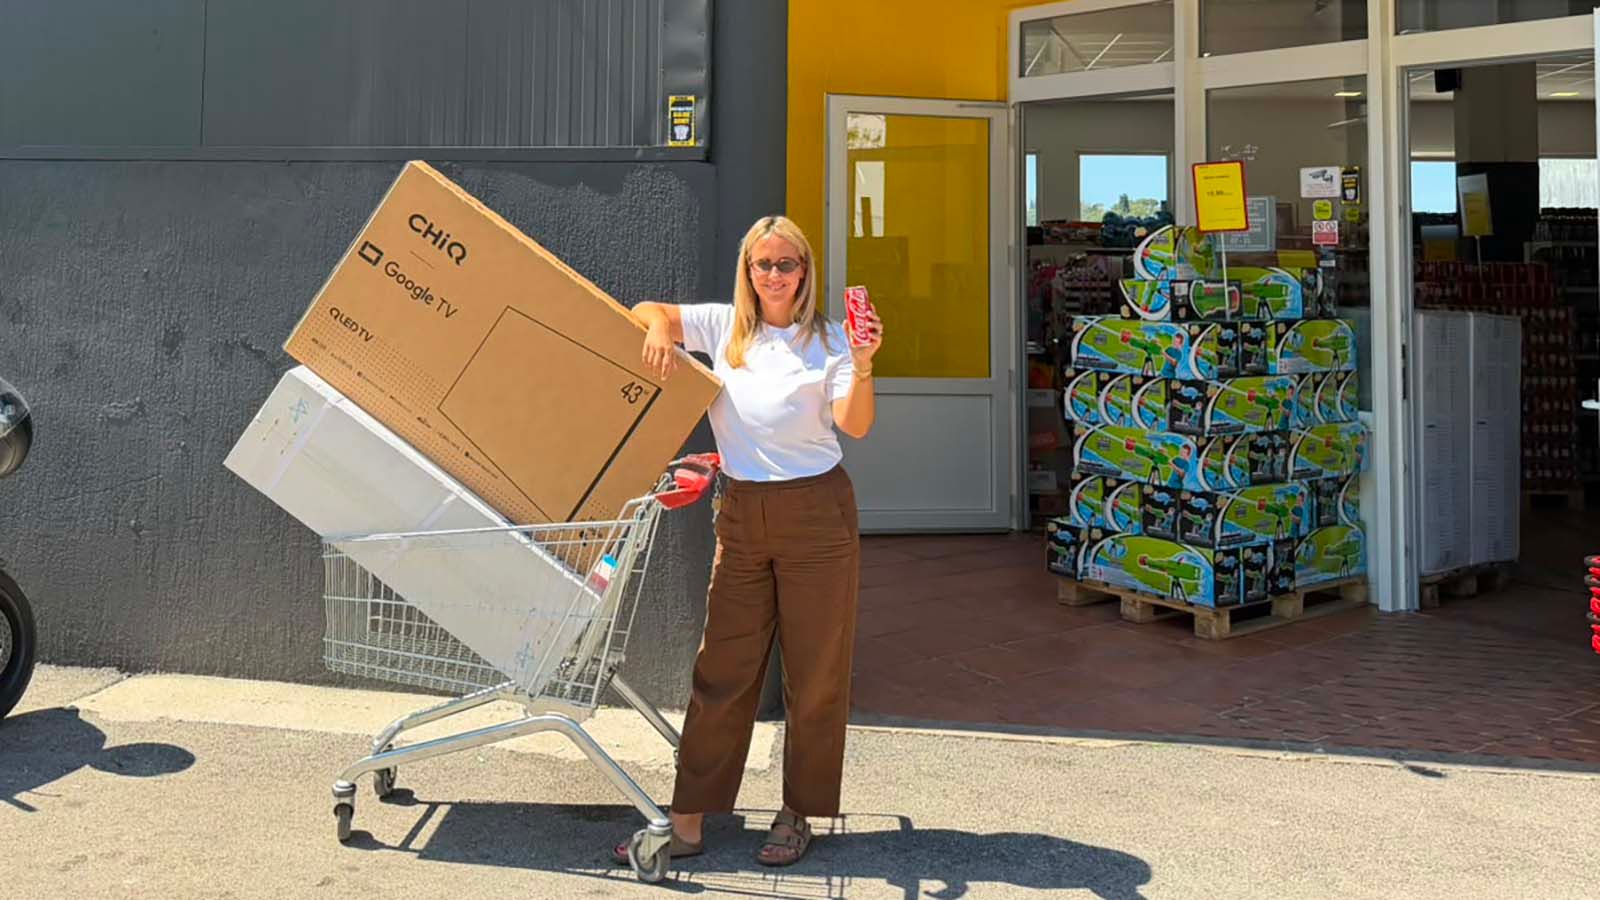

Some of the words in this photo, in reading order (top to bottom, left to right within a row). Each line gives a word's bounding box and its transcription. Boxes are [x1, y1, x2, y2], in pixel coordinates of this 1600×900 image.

[408, 213, 467, 266] CHiQ
[384, 260, 434, 305] Google
[436, 297, 458, 319] TV
[329, 307, 359, 332] QLED
[358, 326, 374, 342] TV
